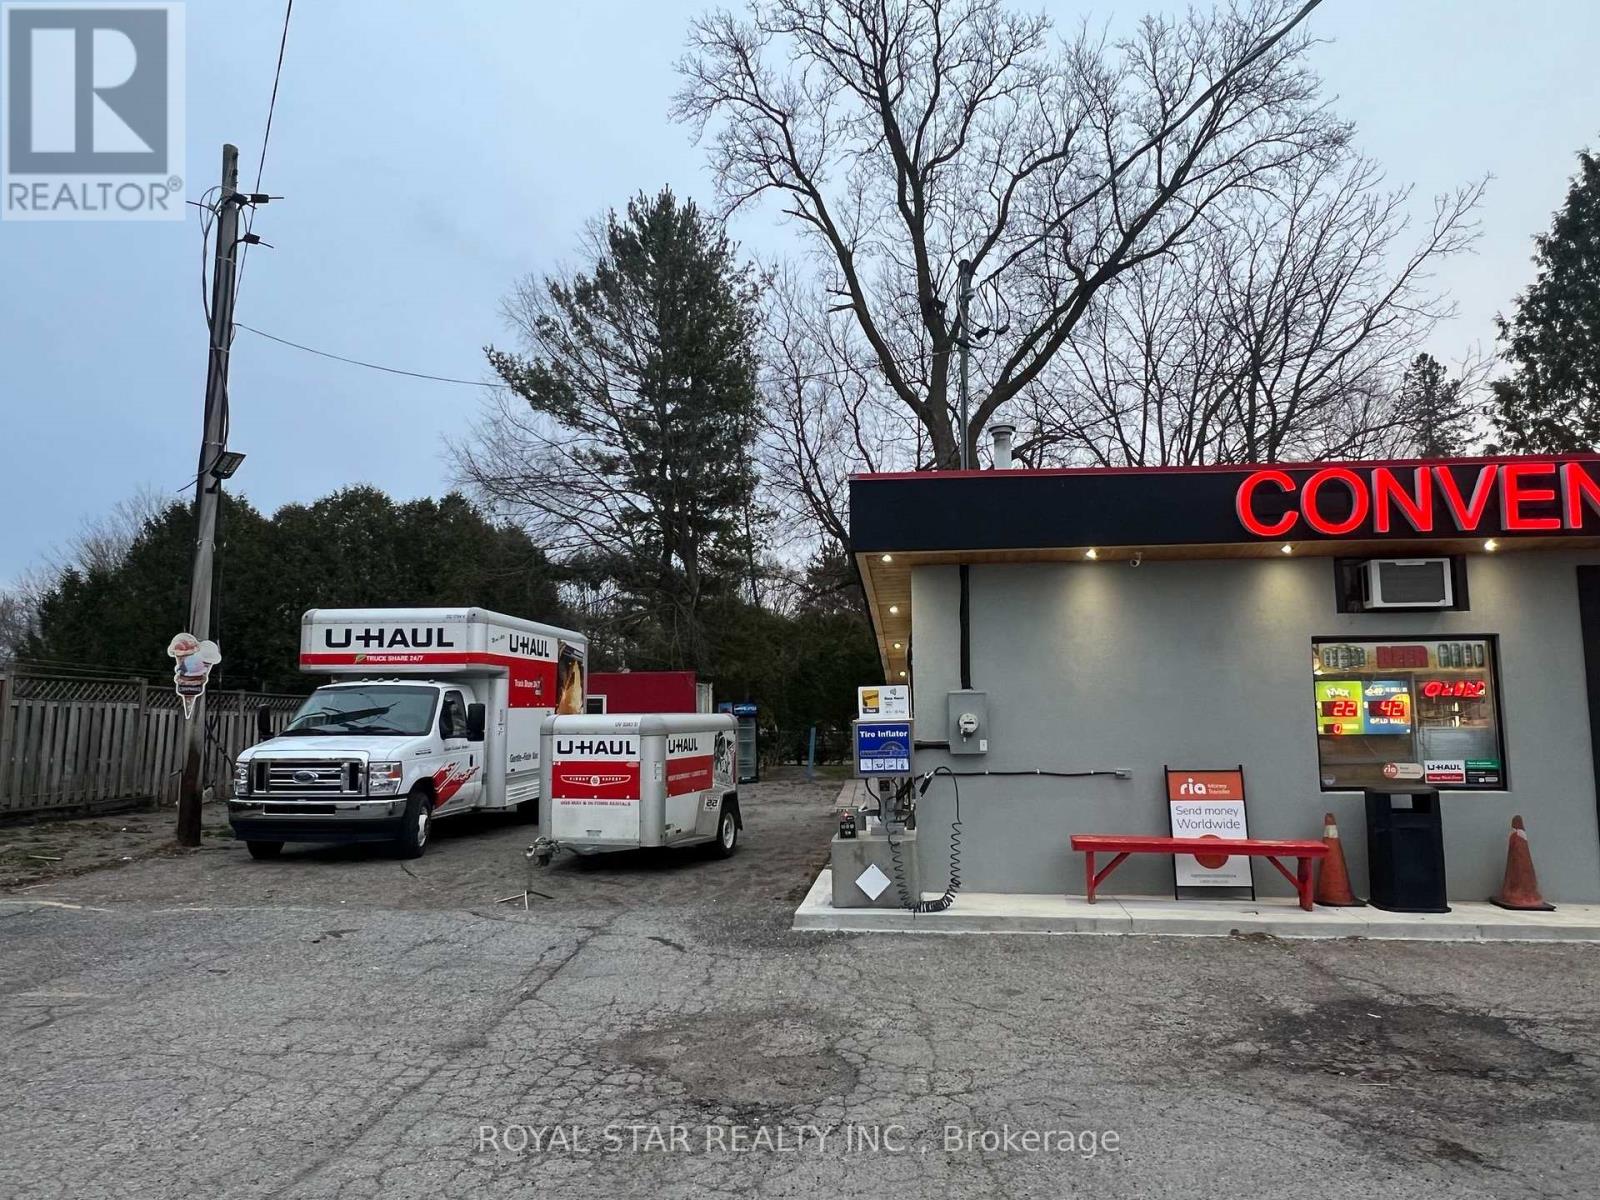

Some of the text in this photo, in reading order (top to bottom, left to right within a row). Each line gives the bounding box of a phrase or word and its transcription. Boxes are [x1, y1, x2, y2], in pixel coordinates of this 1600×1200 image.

[1235, 462, 1600, 537] CONVEN
[325, 628, 454, 649] U-HAUL
[509, 633, 550, 658] U-HAUL
[1333, 701, 1357, 716] 22
[1380, 701, 1403, 716] 42
[877, 730, 908, 738] Inflator
[556, 740, 637, 755] U-HAUL
[668, 737, 699, 754] U-HAUL
[1180, 777, 1207, 795] ria
[1175, 805, 1239, 818] Send money
[1176, 819, 1241, 830] Worldwide
